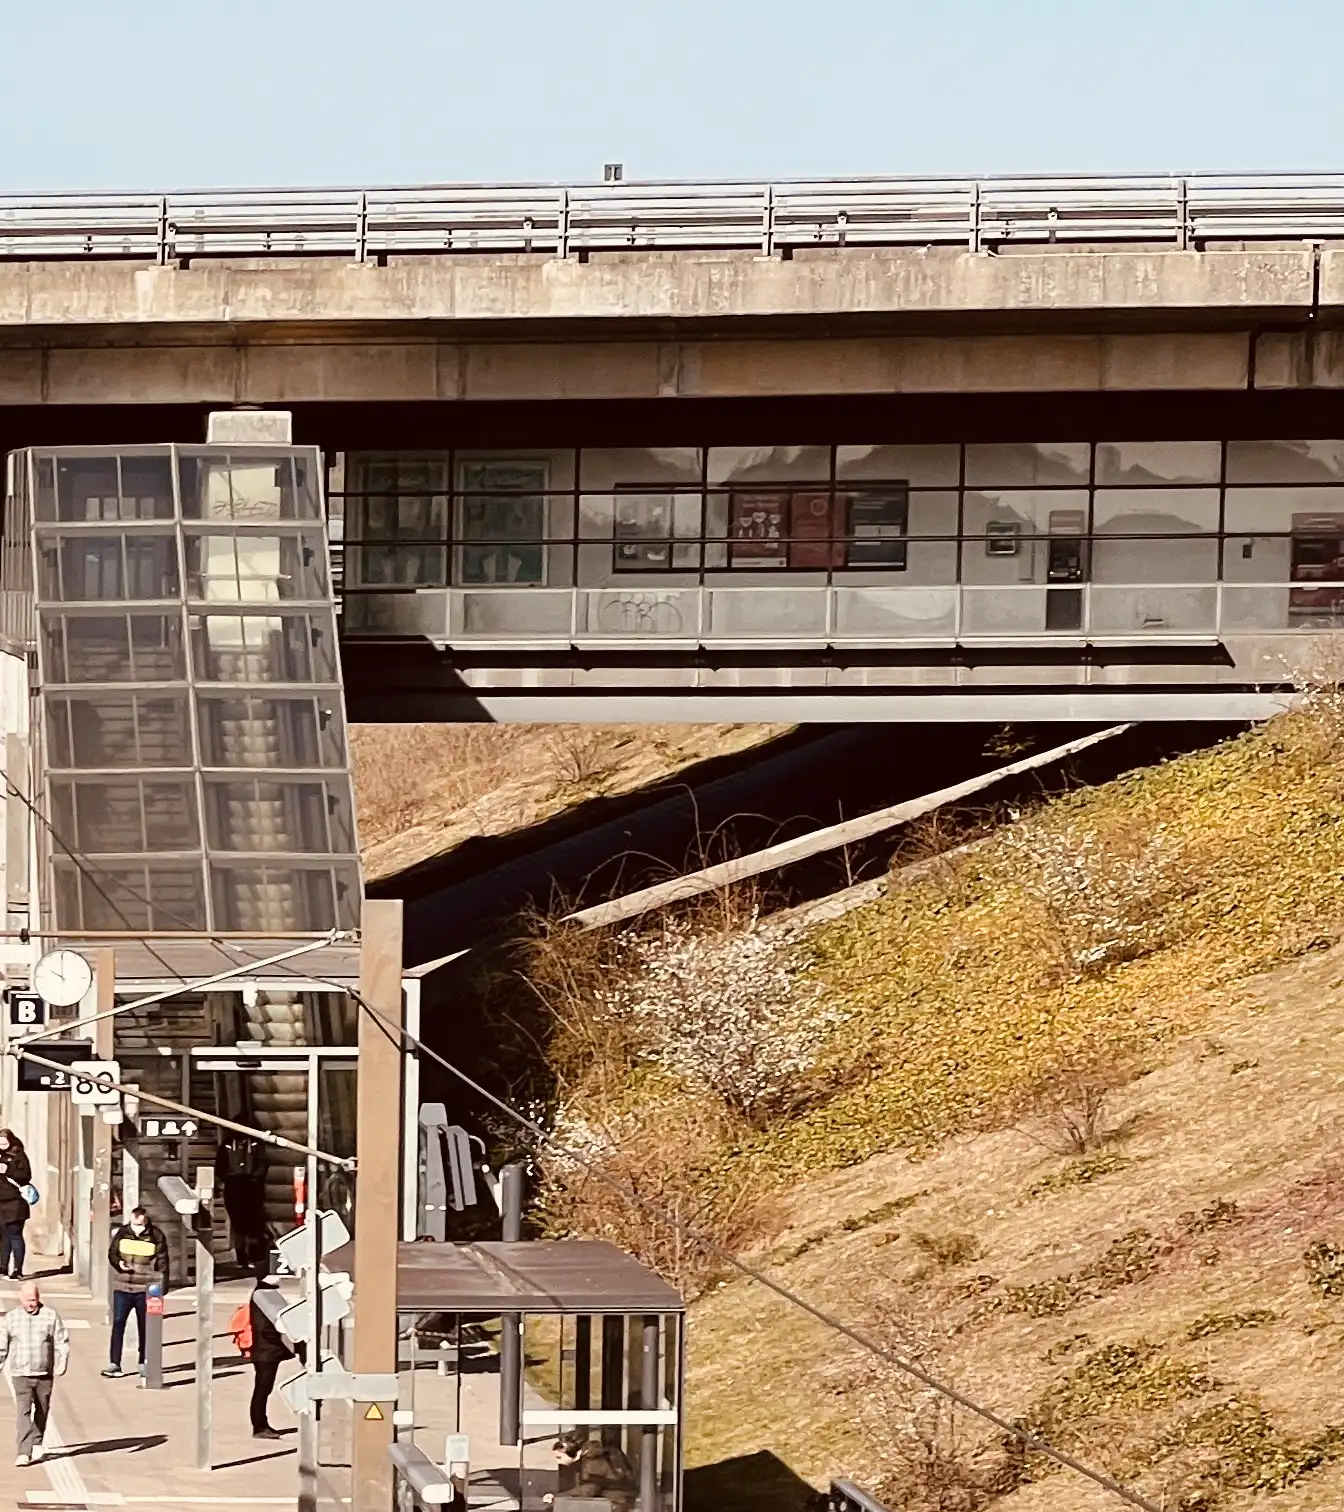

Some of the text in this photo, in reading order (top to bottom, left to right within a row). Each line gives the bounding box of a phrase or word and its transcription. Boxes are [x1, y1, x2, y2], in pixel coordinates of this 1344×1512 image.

[18, 1000, 36, 1023] B
[75, 1071, 115, 1095] 80
[276, 1256, 290, 1274] 2
